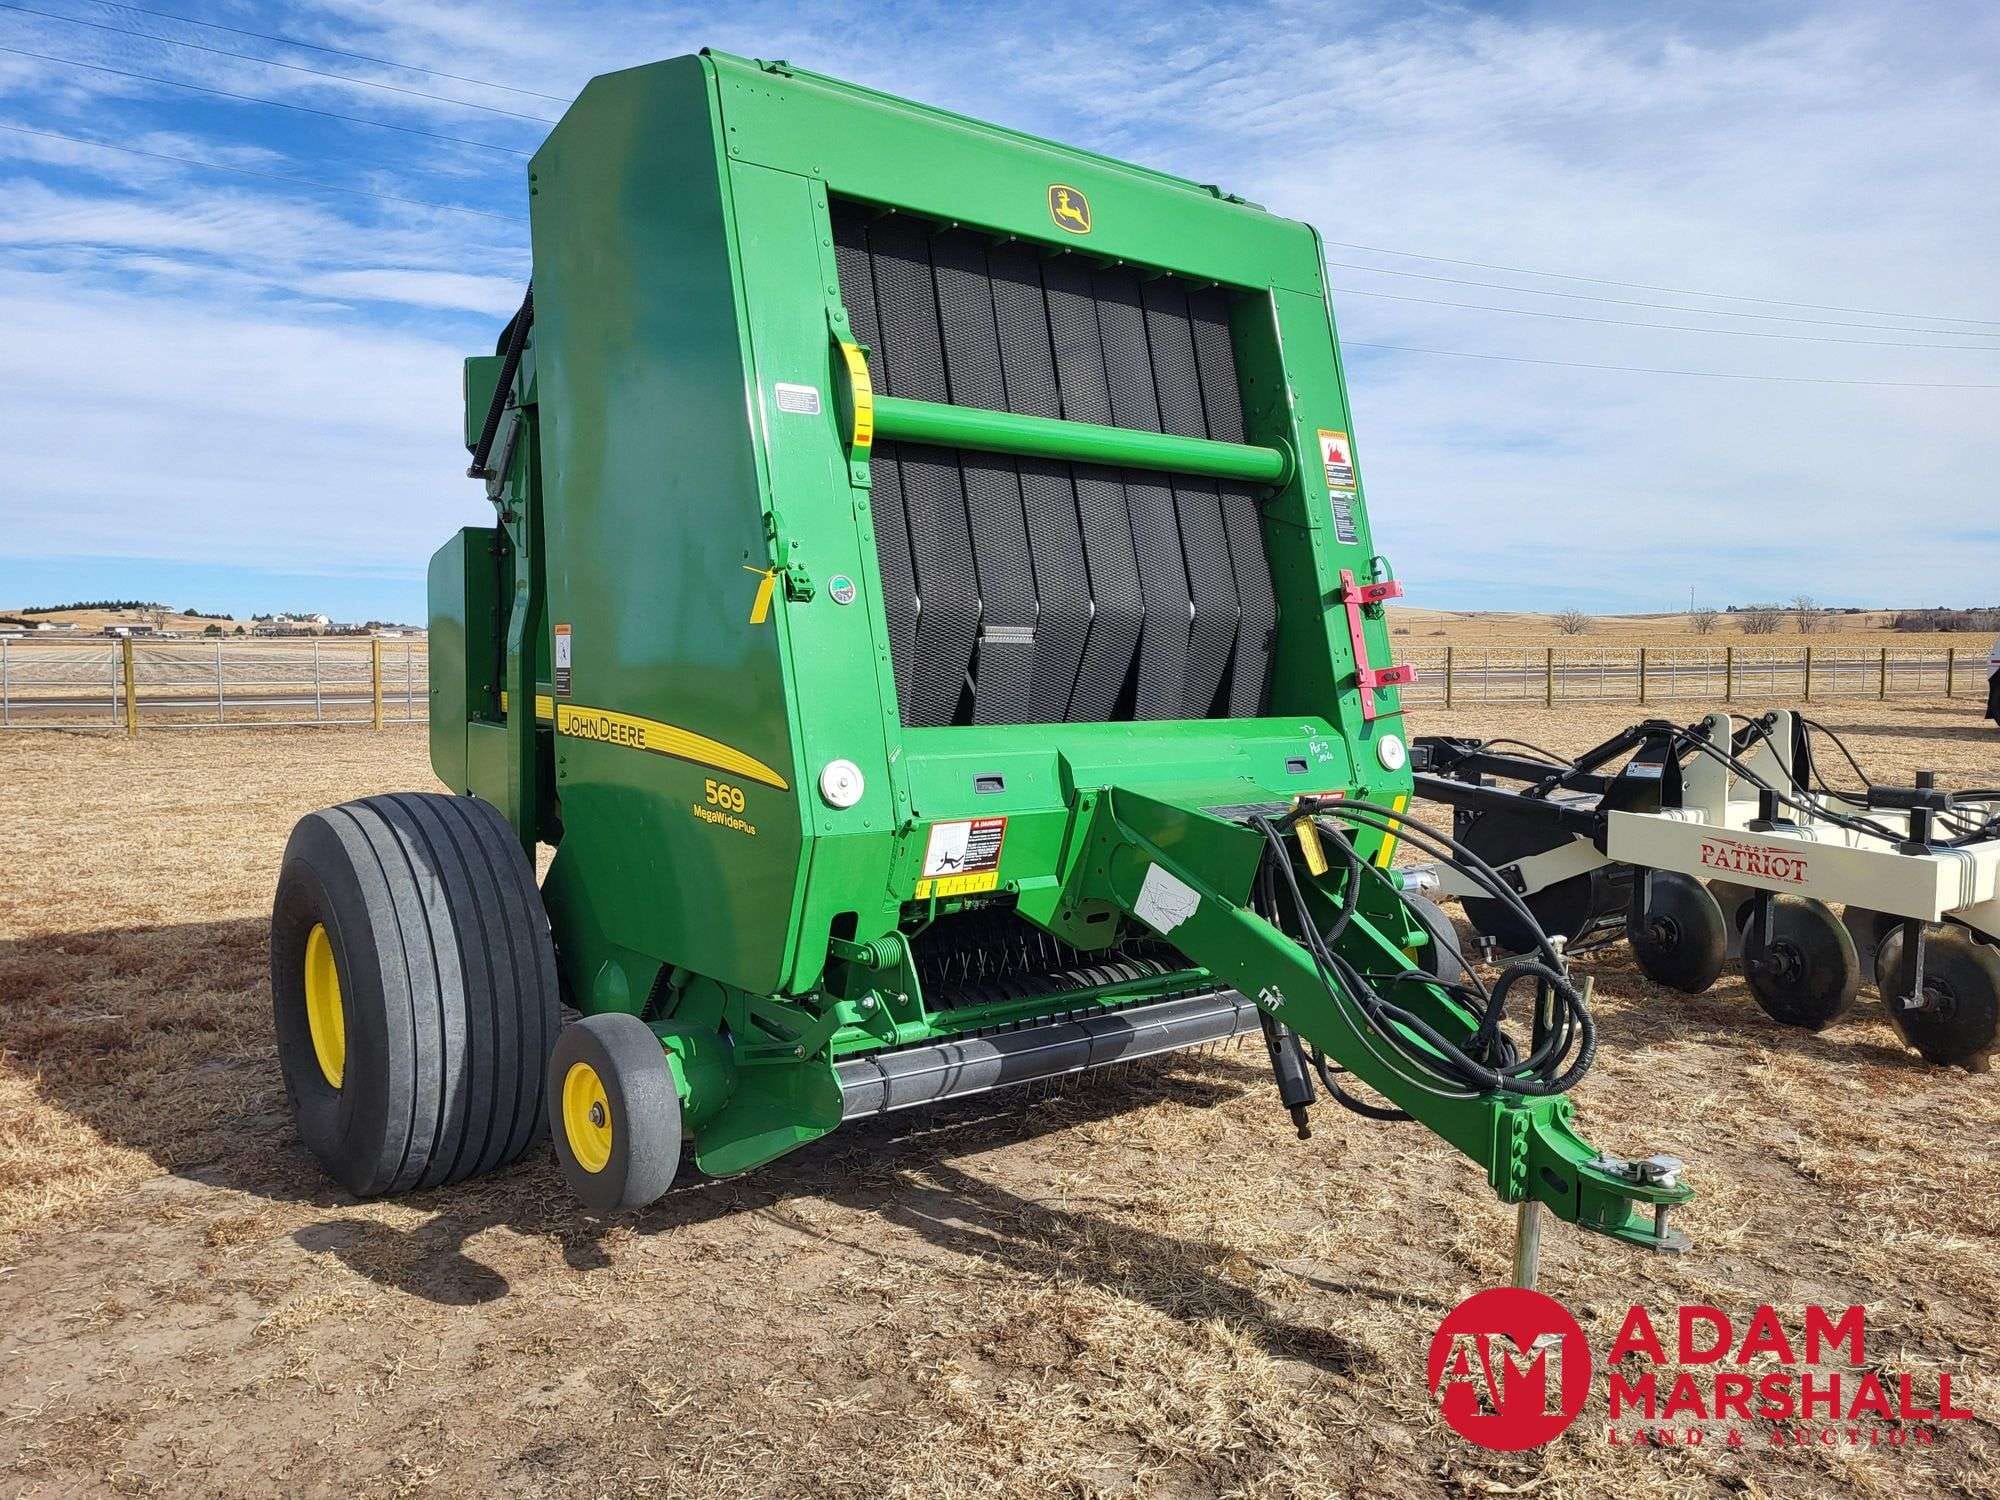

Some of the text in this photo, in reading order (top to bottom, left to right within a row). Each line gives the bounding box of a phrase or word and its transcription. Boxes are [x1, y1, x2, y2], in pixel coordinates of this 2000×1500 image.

[564, 711, 646, 747] JOHN DEERE
[705, 778, 746, 814] 569
[693, 803, 757, 836] MegaWidePlus
[1700, 843, 1808, 885] PATRIOT
